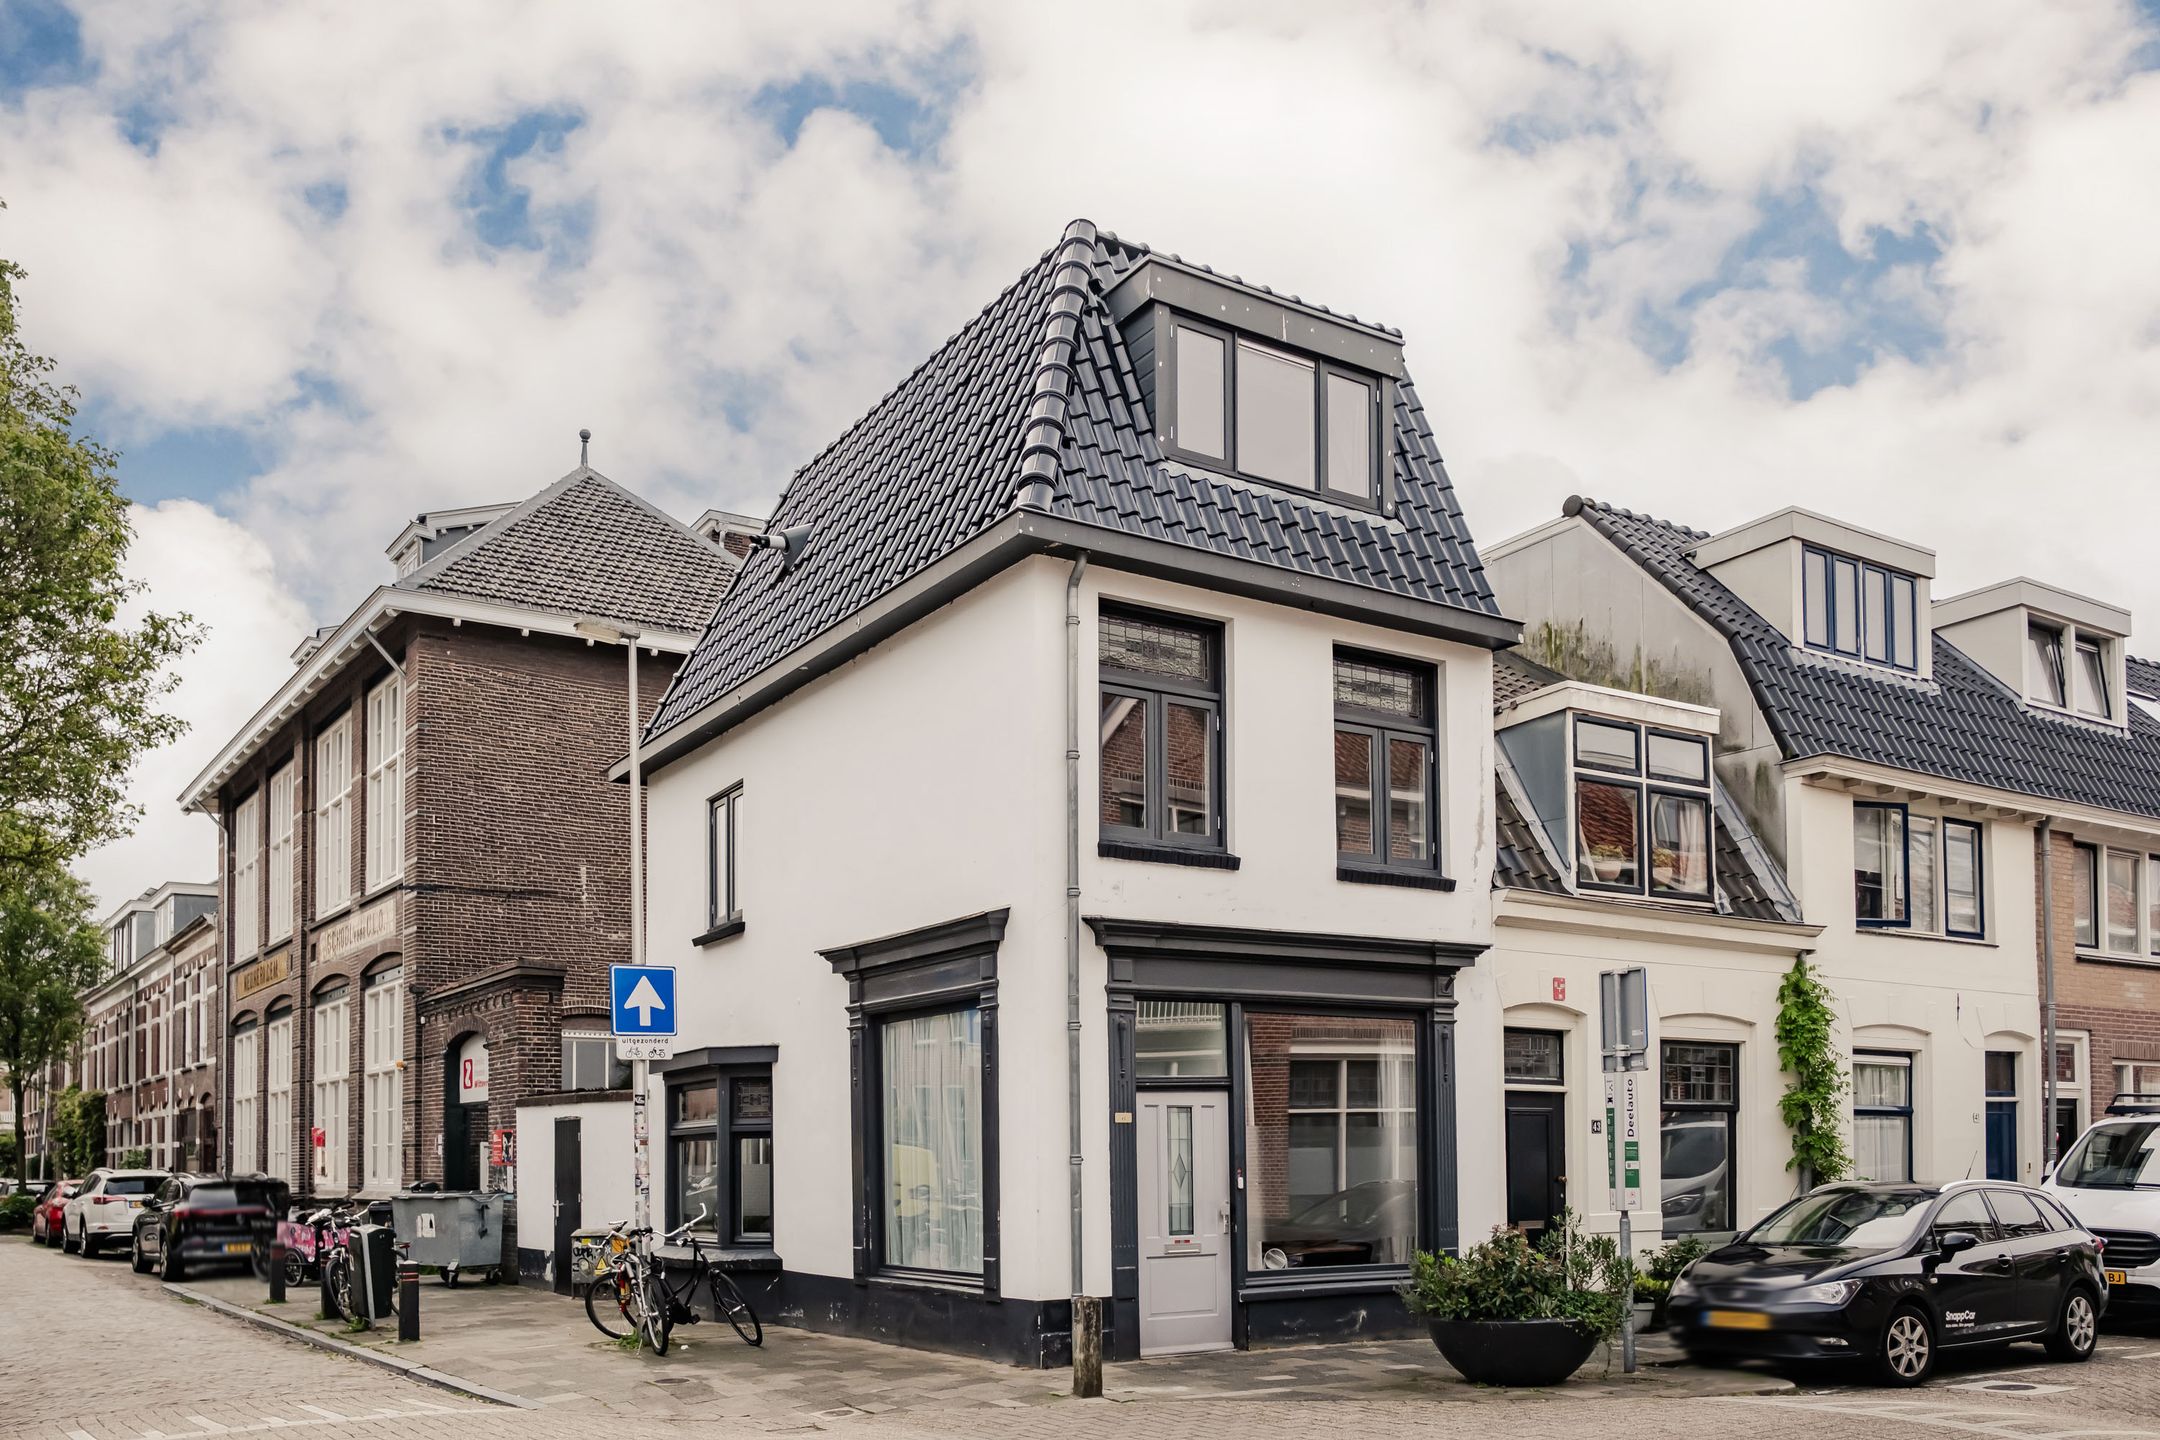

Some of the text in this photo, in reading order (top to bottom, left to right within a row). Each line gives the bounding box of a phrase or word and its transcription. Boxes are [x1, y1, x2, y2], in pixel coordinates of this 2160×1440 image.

[326, 921, 353, 952] SCHOOL
[1626, 1079, 1635, 1137] Deelauto
[2108, 1272, 2121, 1282] BJ
[1945, 1310, 1976, 1322] SnappCar
